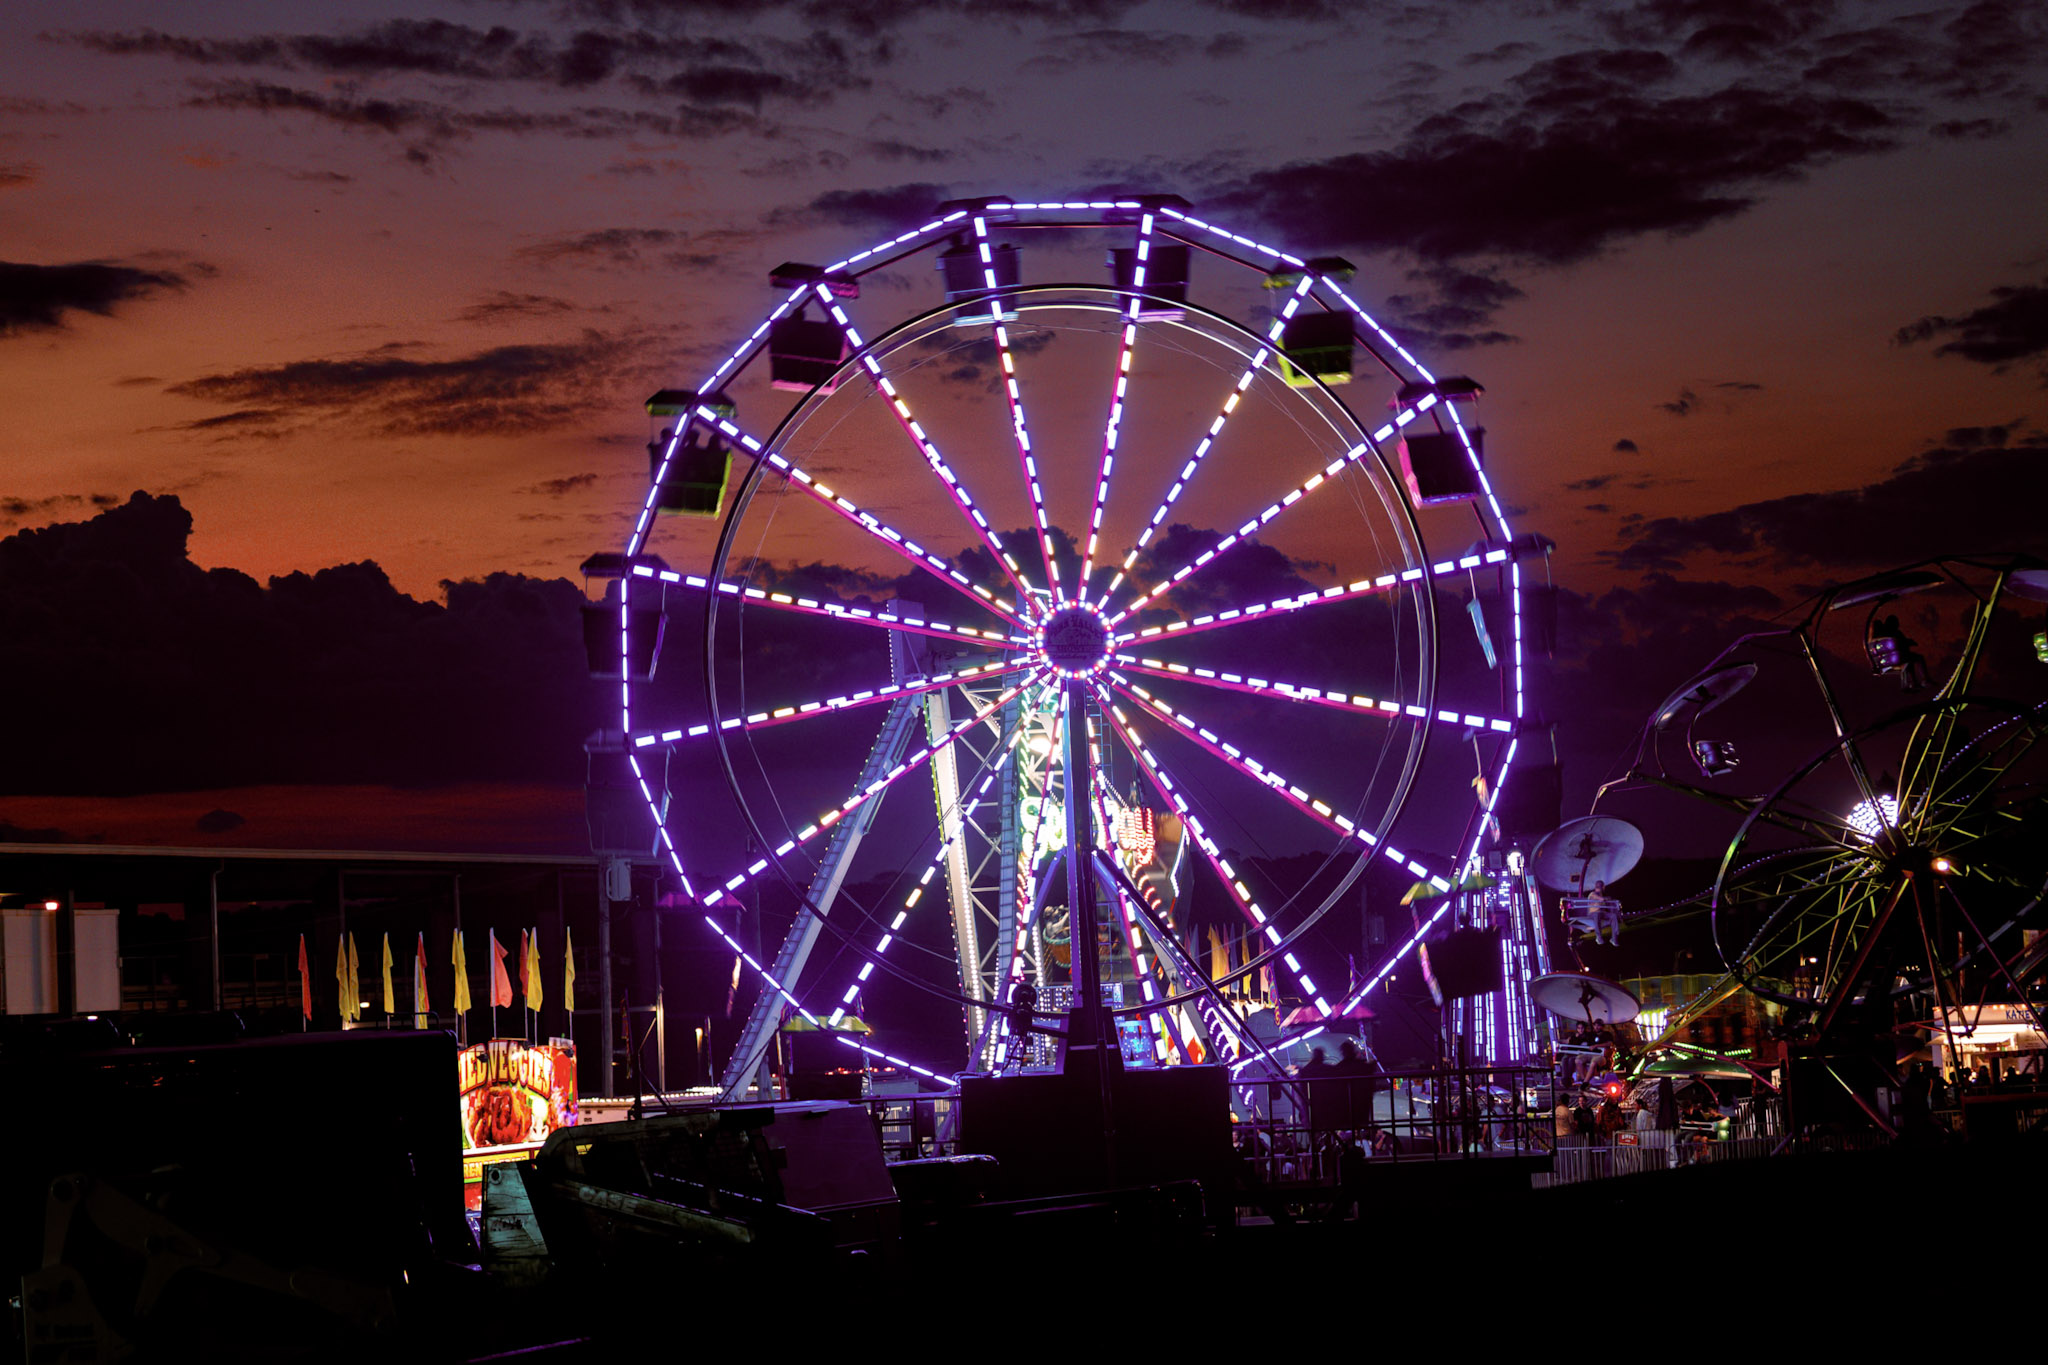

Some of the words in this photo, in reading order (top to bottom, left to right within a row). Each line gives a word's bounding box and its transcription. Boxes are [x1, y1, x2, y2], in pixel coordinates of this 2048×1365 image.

[458, 1043, 488, 1096] IED
[488, 1040, 553, 1099] VEGGIES
[578, 1186, 640, 1213] CASE
